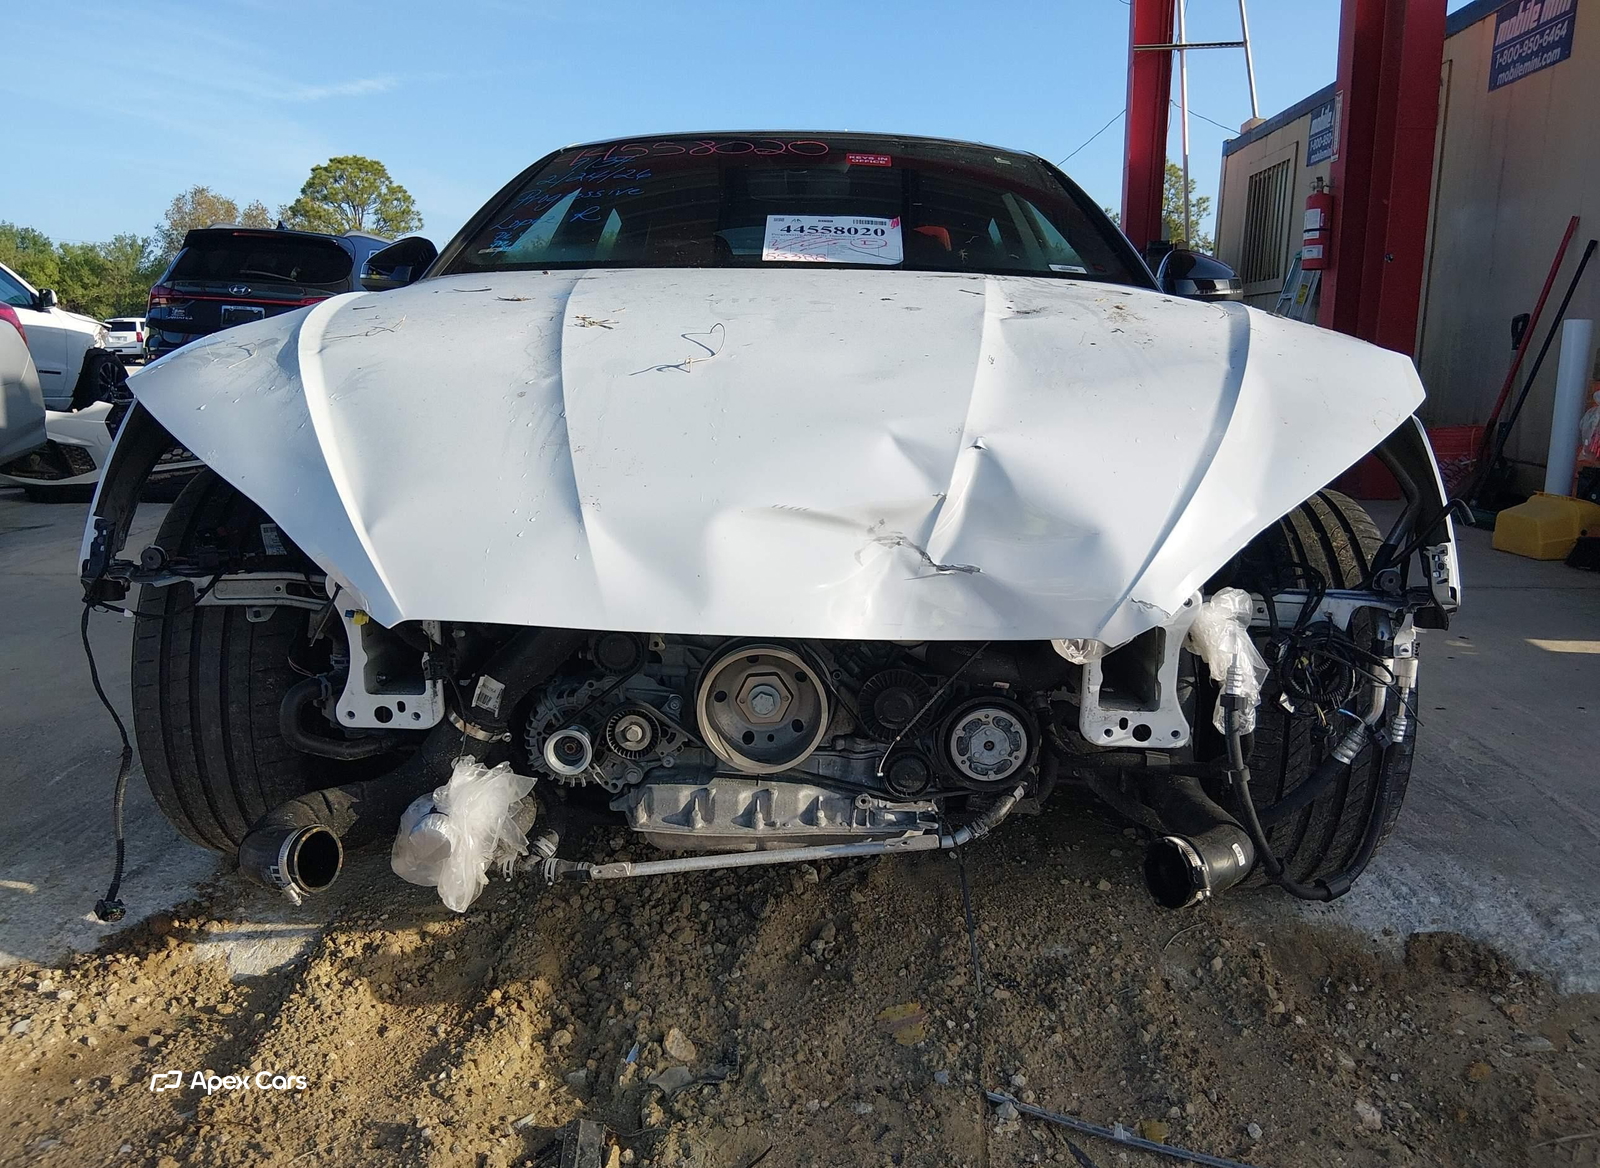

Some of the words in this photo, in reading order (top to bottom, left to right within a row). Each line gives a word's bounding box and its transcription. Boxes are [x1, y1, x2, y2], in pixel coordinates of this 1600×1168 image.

[1495, 0, 1541, 46] mobile
[1495, 20, 1568, 68] 1-800-950-6464
[1496, 48, 1561, 86] mobilemini.com
[512, 188, 645, 212] Progessive
[780, 225, 886, 236] 44558020
